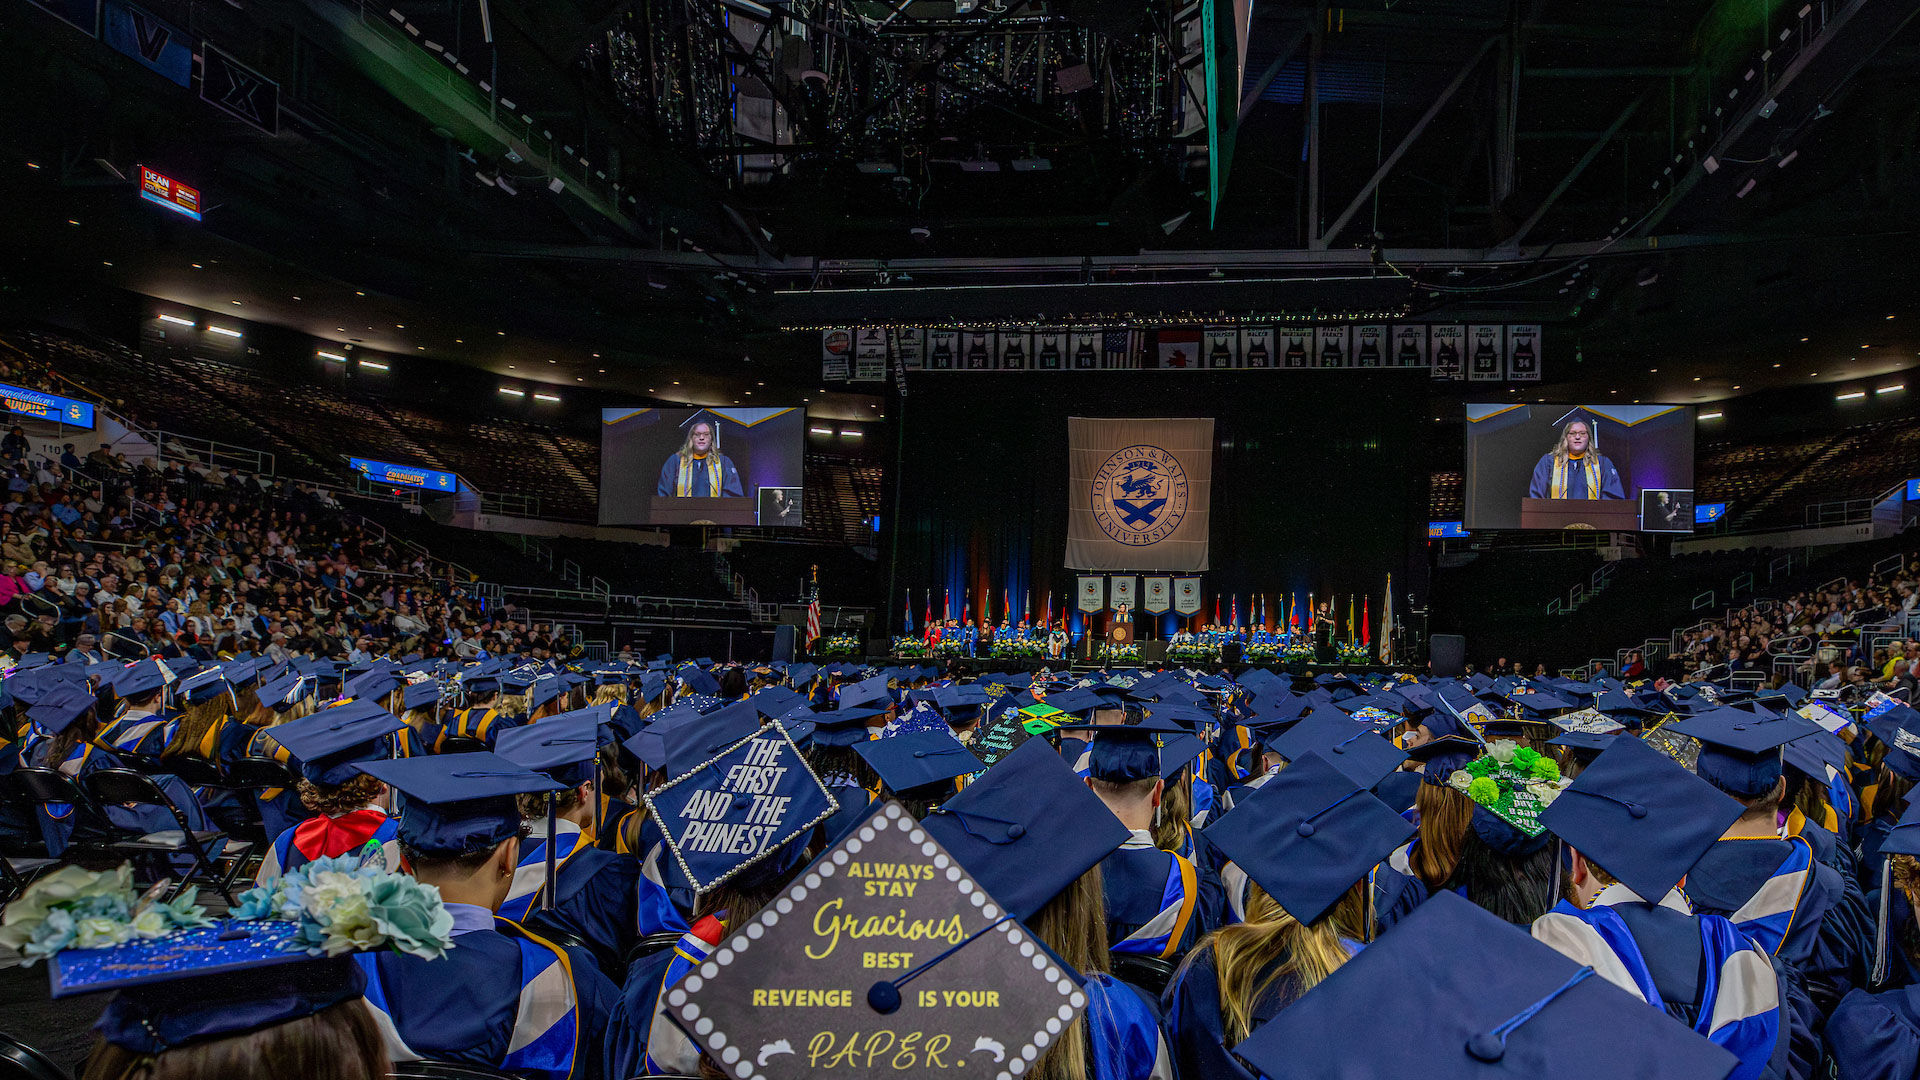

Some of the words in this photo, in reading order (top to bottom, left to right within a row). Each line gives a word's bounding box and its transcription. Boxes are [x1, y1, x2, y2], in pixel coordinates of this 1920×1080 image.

[145, 170, 169, 188] DEAN
[145, 183, 169, 198] COLLEGE
[1517, 358, 1530, 368] 34
[43, 444, 61, 455] 110
[386, 471, 425, 486] GRADUATES
[1093, 447, 1144, 497] JOHNSON
[1148, 449, 1157, 458] &
[1161, 453, 1185, 498] WALES
[1097, 510, 1181, 544] UNIVERSITY
[987, 732, 1009, 742] Seems
[990, 723, 1017, 735] Always
[749, 738, 788, 768] THE
[980, 739, 1014, 751] Impossible
[720, 764, 788, 796] FIRST
[679, 789, 733, 822] AND
[747, 796, 792, 828] THE
[678, 821, 778, 856] PHINEST
[847, 862, 935, 881] ALWAYS
[864, 881, 917, 899] STAY
[804, 898, 970, 960] Gracious.
[862, 952, 913, 970] BEST
[752, 989, 853, 1008] REVENGE
[918, 990, 939, 1008] IS
[942, 990, 1000, 1008] YOUR
